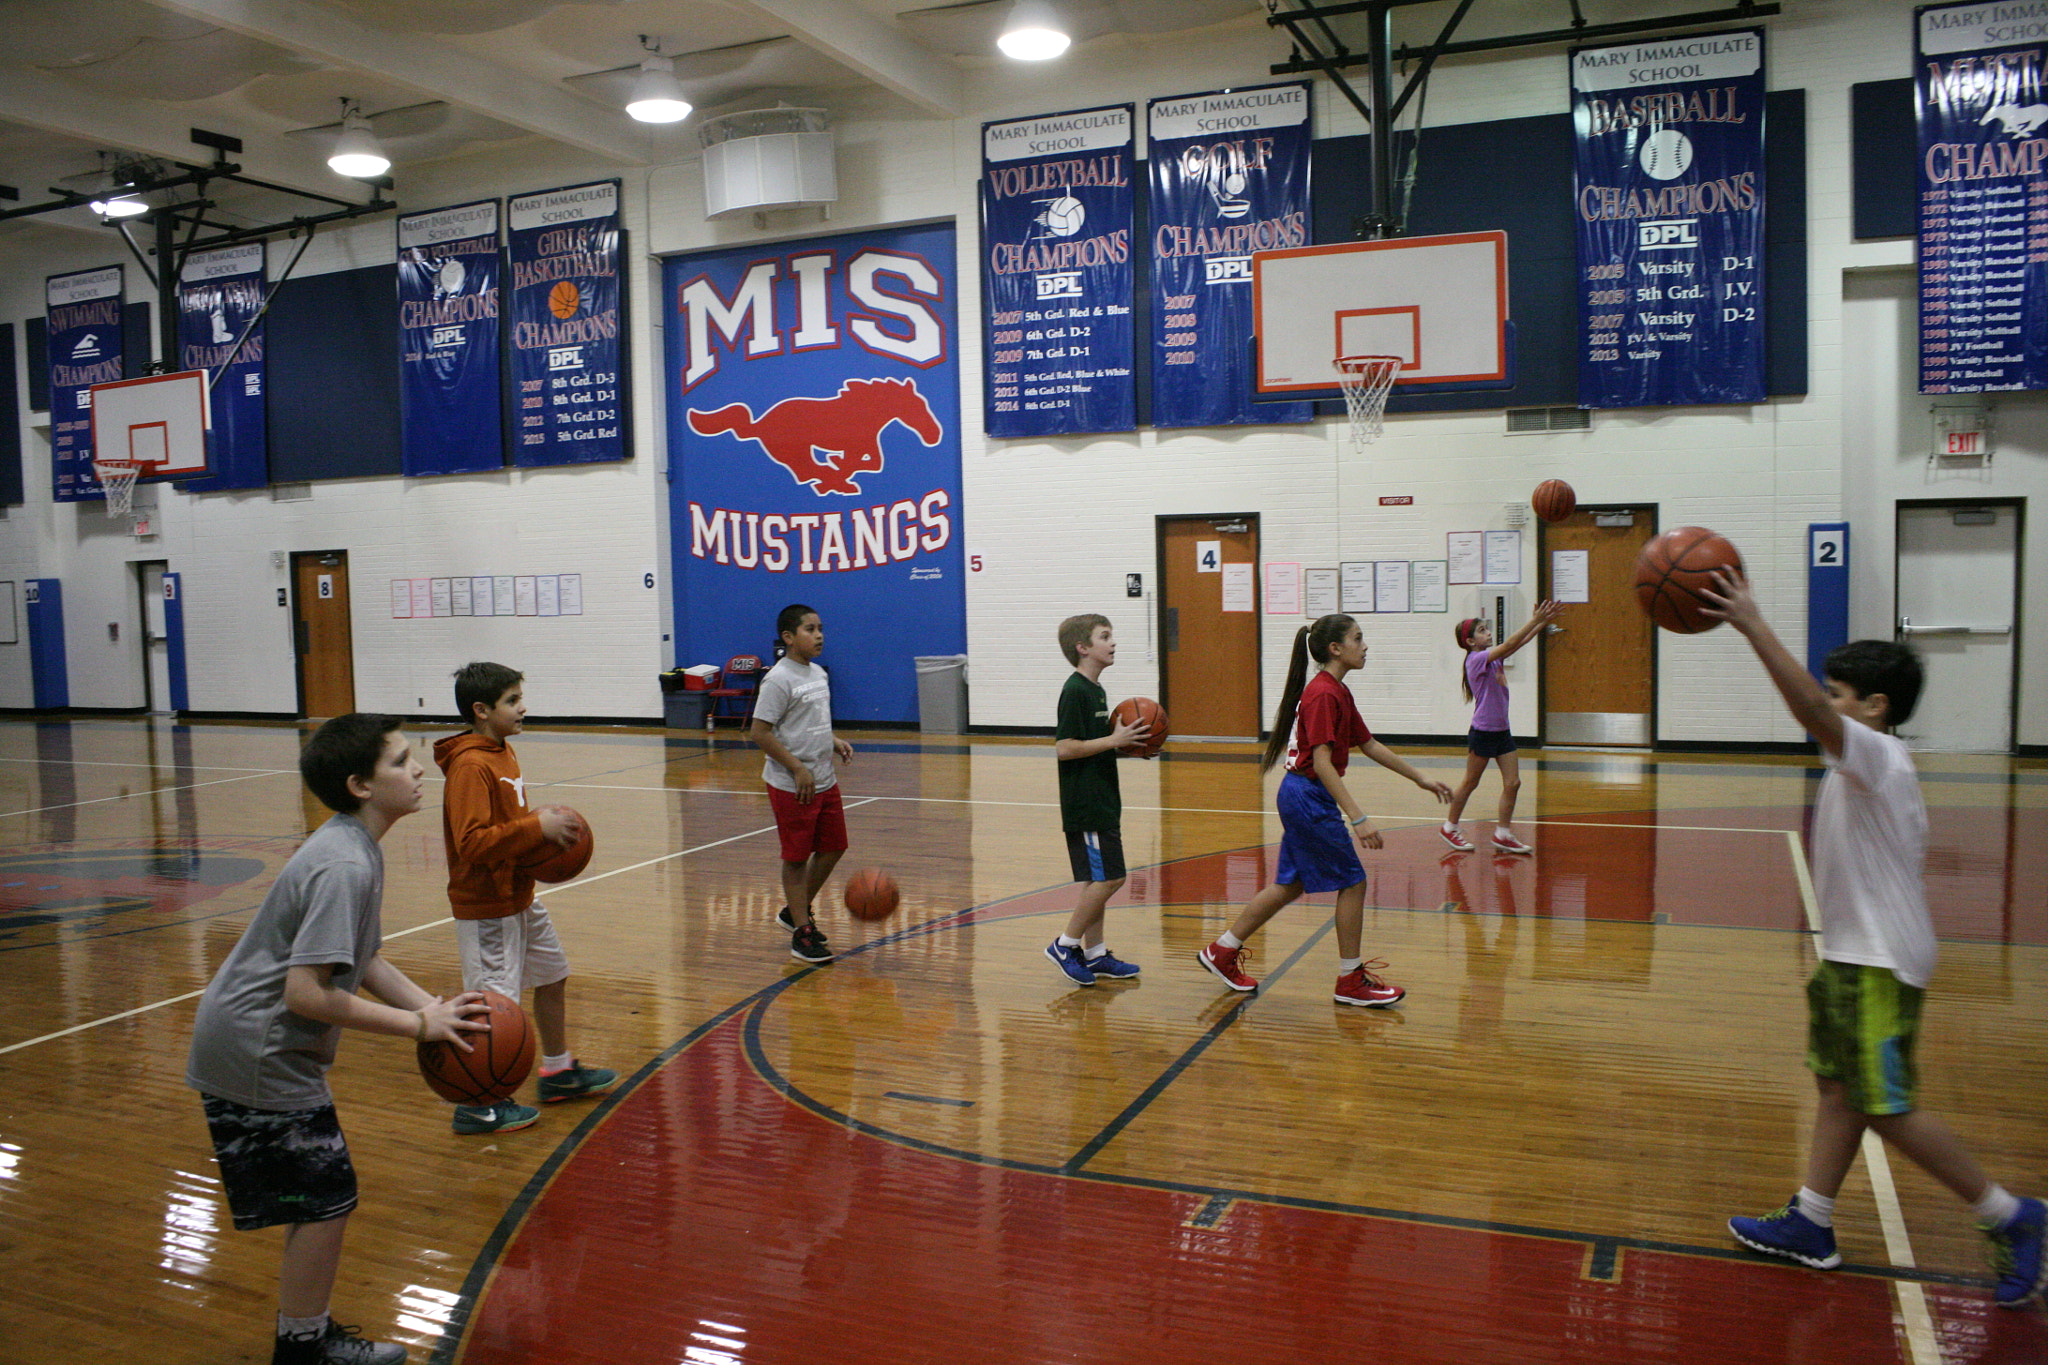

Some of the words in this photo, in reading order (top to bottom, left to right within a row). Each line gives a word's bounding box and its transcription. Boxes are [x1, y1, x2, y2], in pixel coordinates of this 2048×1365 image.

[1929, 11, 1986, 31] MARY
[1579, 51, 1630, 69] MARY
[1636, 38, 1754, 63] IMMACULATE
[1629, 64, 1704, 84] SCHOOL
[1156, 102, 1198, 119] MARY
[1203, 91, 1302, 113] IMMACULATE
[1587, 86, 1747, 137] BASEBALL
[990, 126, 1030, 141] MARY
[1034, 113, 1126, 135] IMMACULATE
[1197, 114, 1260, 132] SCHOOL
[1029, 137, 1087, 153] SCHOOL
[1183, 137, 1274, 177] GOLF
[989, 155, 1128, 200] VOLLEYBALL
[513, 200, 543, 212] MARY
[546, 187, 613, 207] IMMACULATE
[1580, 172, 1755, 222] CHAMPIONS
[1949, 189, 1982, 199] Varsity
[1949, 203, 1982, 213] Varsity
[1985, 199, 2025, 210] Baseball
[432, 208, 493, 228] IMMACULATE
[541, 208, 584, 223] SCHOOL
[1949, 217, 1982, 226] Varsity
[1985, 213, 2025, 224] Football
[428, 226, 466, 241] SCHOOL
[538, 228, 587, 256] GIRLS
[1157, 211, 1305, 258] CHAMPIONS
[1639, 224, 1698, 245] DPL
[1949, 231, 1982, 241] Varsity
[1985, 227, 2024, 238] Football
[432, 236, 498, 258] VOLLEYBALL
[992, 229, 1128, 275] CHAMPIONS
[1949, 245, 1982, 254] Varsity
[1985, 241, 2024, 252] Football
[204, 264, 238, 276] SCHOOL
[513, 249, 615, 290] BASKETBALL
[1205, 260, 1253, 280] DPL
[1588, 263, 1625, 280] 2005
[1638, 260, 1695, 278] Varsity
[1723, 256, 1754, 271] D-1
[1037, 276, 1082, 295] DPL
[1588, 289, 1626, 305] 2005
[1636, 286, 1662, 302] 5th
[1667, 284, 1705, 300] Grd.
[1725, 281, 1756, 300] J.V.
[401, 287, 499, 329] CHAMPIONS
[1164, 294, 1197, 310] 2007
[50, 300, 120, 335] SWIMMING
[678, 246, 946, 396] MIS
[993, 310, 1023, 325] 2007
[1025, 311, 1042, 321] 5th
[1045, 309, 1065, 320] Grd.
[1069, 307, 1089, 317] Red
[1093, 306, 1103, 316] &
[1107, 305, 1130, 315] Blue
[1164, 313, 1197, 328] 2008
[1588, 314, 1625, 329] 2007
[1638, 311, 1696, 328] Varsity
[1723, 307, 1755, 322] D-2
[1949, 314, 1982, 324] Varsity
[433, 328, 466, 344] DPL
[515, 309, 616, 350] CHAMPIONS
[994, 329, 1023, 344] 2009
[1026, 330, 1043, 341] 6th
[1046, 328, 1066, 339] Grd.
[1070, 326, 1091, 337] D-2
[1588, 333, 1620, 345] 2012
[1648, 334, 1657, 342] &
[1658, 332, 1693, 343] Varsity
[1164, 332, 1197, 347] 2009
[1965, 341, 2004, 351] Football
[549, 351, 584, 367] DPL
[994, 349, 1023, 363] 2009
[1026, 349, 1043, 360] 7th
[1046, 347, 1066, 358] Grd.
[1070, 346, 1090, 356] D-1
[1589, 349, 1620, 361] 2013
[1627, 349, 1662, 360] Varsity
[54, 355, 122, 387] CHAMPIONS
[994, 372, 1018, 383] 2011
[1024, 374, 1037, 382] 5th
[1055, 371, 1074, 380] Red,
[1075, 370, 1095, 379] Blue
[1096, 369, 1104, 377] &
[1105, 368, 1130, 376] White
[1965, 369, 2004, 379] Baseball
[521, 380, 544, 392] 2007
[552, 377, 567, 389] 8th
[570, 375, 593, 387] Grd.
[596, 372, 615, 384] D-3
[994, 386, 1019, 398] 2012
[1057, 385, 1071, 394] D-2
[1072, 384, 1092, 393] Blue
[553, 394, 568, 405] 8th
[571, 392, 594, 403] Grd.
[597, 390, 616, 401] D-1
[995, 401, 1020, 412] 2014
[1057, 400, 1071, 408] D-1
[523, 415, 544, 427] 2012
[557, 413, 571, 424] 7th
[573, 411, 595, 422] Grd.
[597, 409, 615, 420] D-2
[523, 433, 545, 445] 2015
[557, 431, 571, 442] 5th
[573, 429, 596, 440] Grd.
[598, 427, 617, 438] Red
[1948, 432, 1979, 453] EXIT
[1382, 496, 1411, 505] VISITOR
[689, 488, 949, 574] MUSTANGS
[1202, 550, 1217, 569] 4
[1819, 542, 1837, 563] 2
[971, 555, 983, 572] 5
[321, 582, 329, 596] 8
[644, 573, 654, 588] 6
[26, 588, 39, 601] 10
[165, 584, 173, 597] 9
[732, 659, 755, 670] MIS
